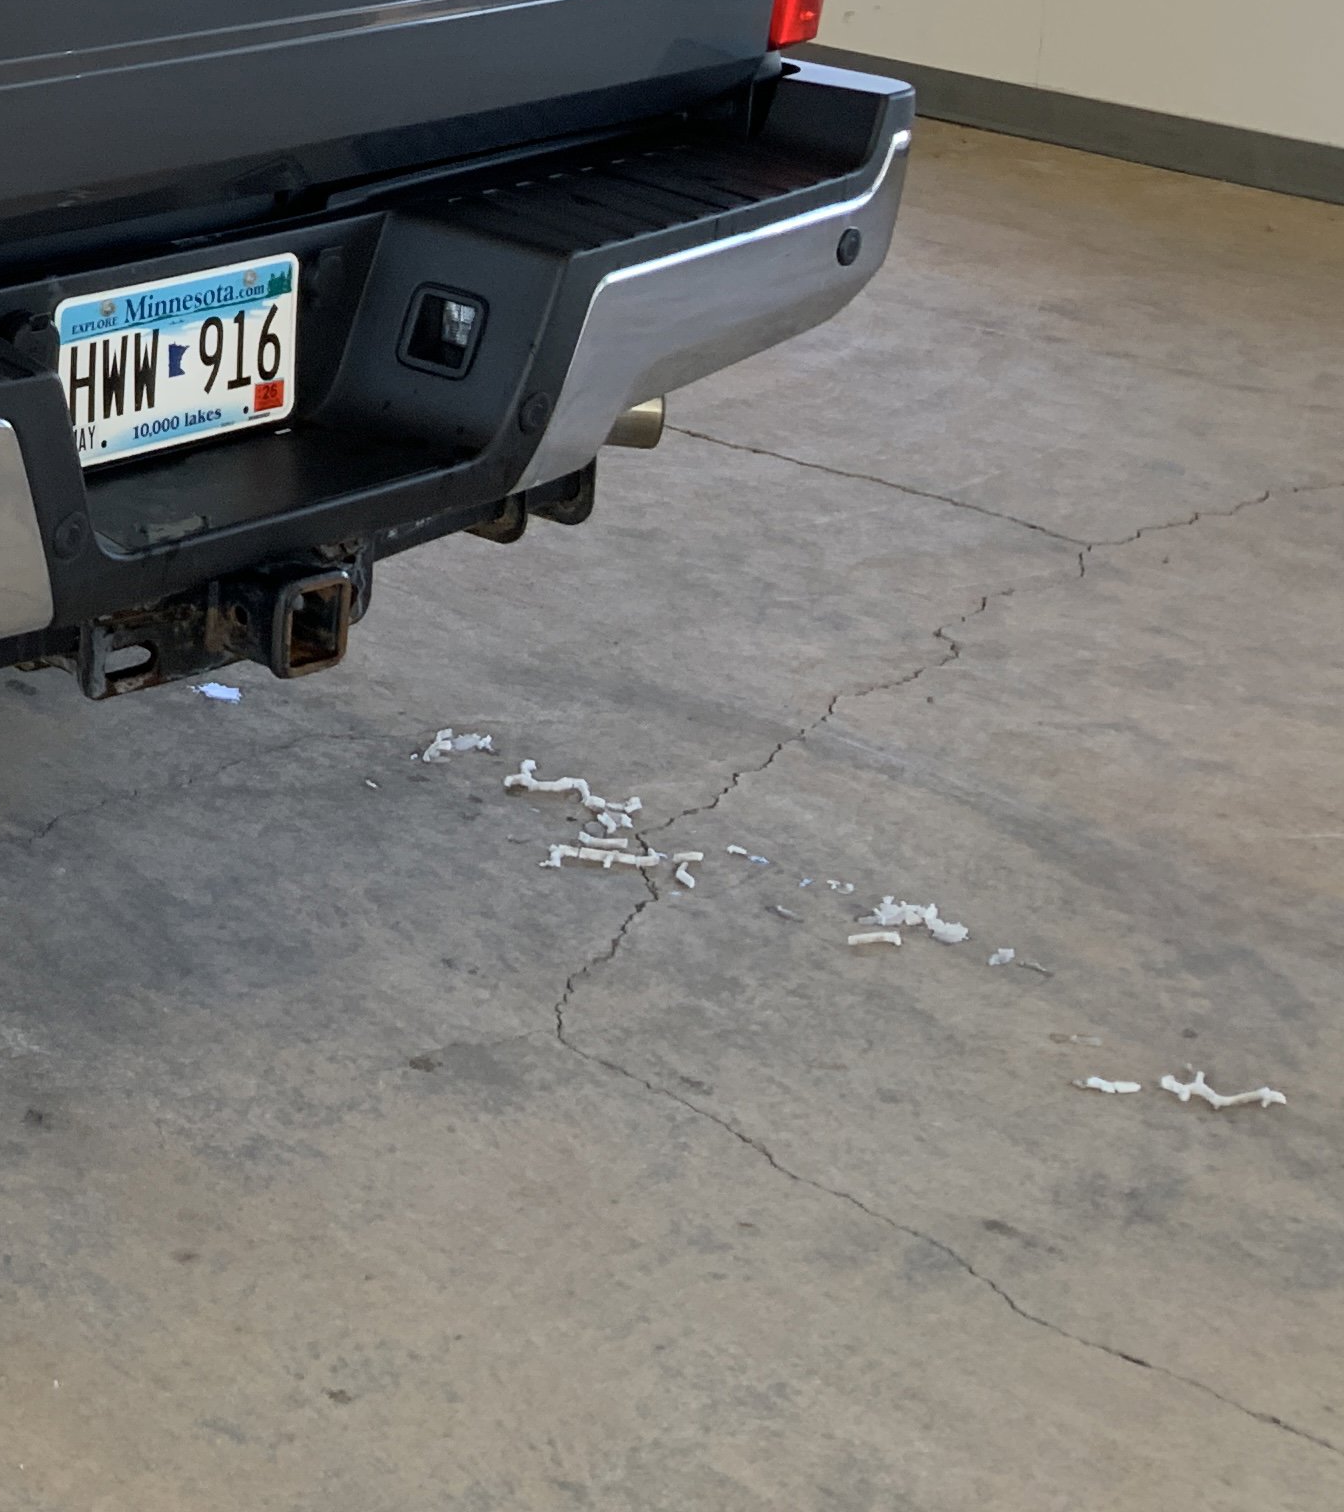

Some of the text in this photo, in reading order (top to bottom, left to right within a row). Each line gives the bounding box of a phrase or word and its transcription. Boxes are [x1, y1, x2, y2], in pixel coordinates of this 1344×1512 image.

[71, 316, 119, 335] EXPLORE
[69, 303, 279, 426] HWW 916
[132, 414, 181, 440] 10,000
[184, 407, 223, 427] lakes
